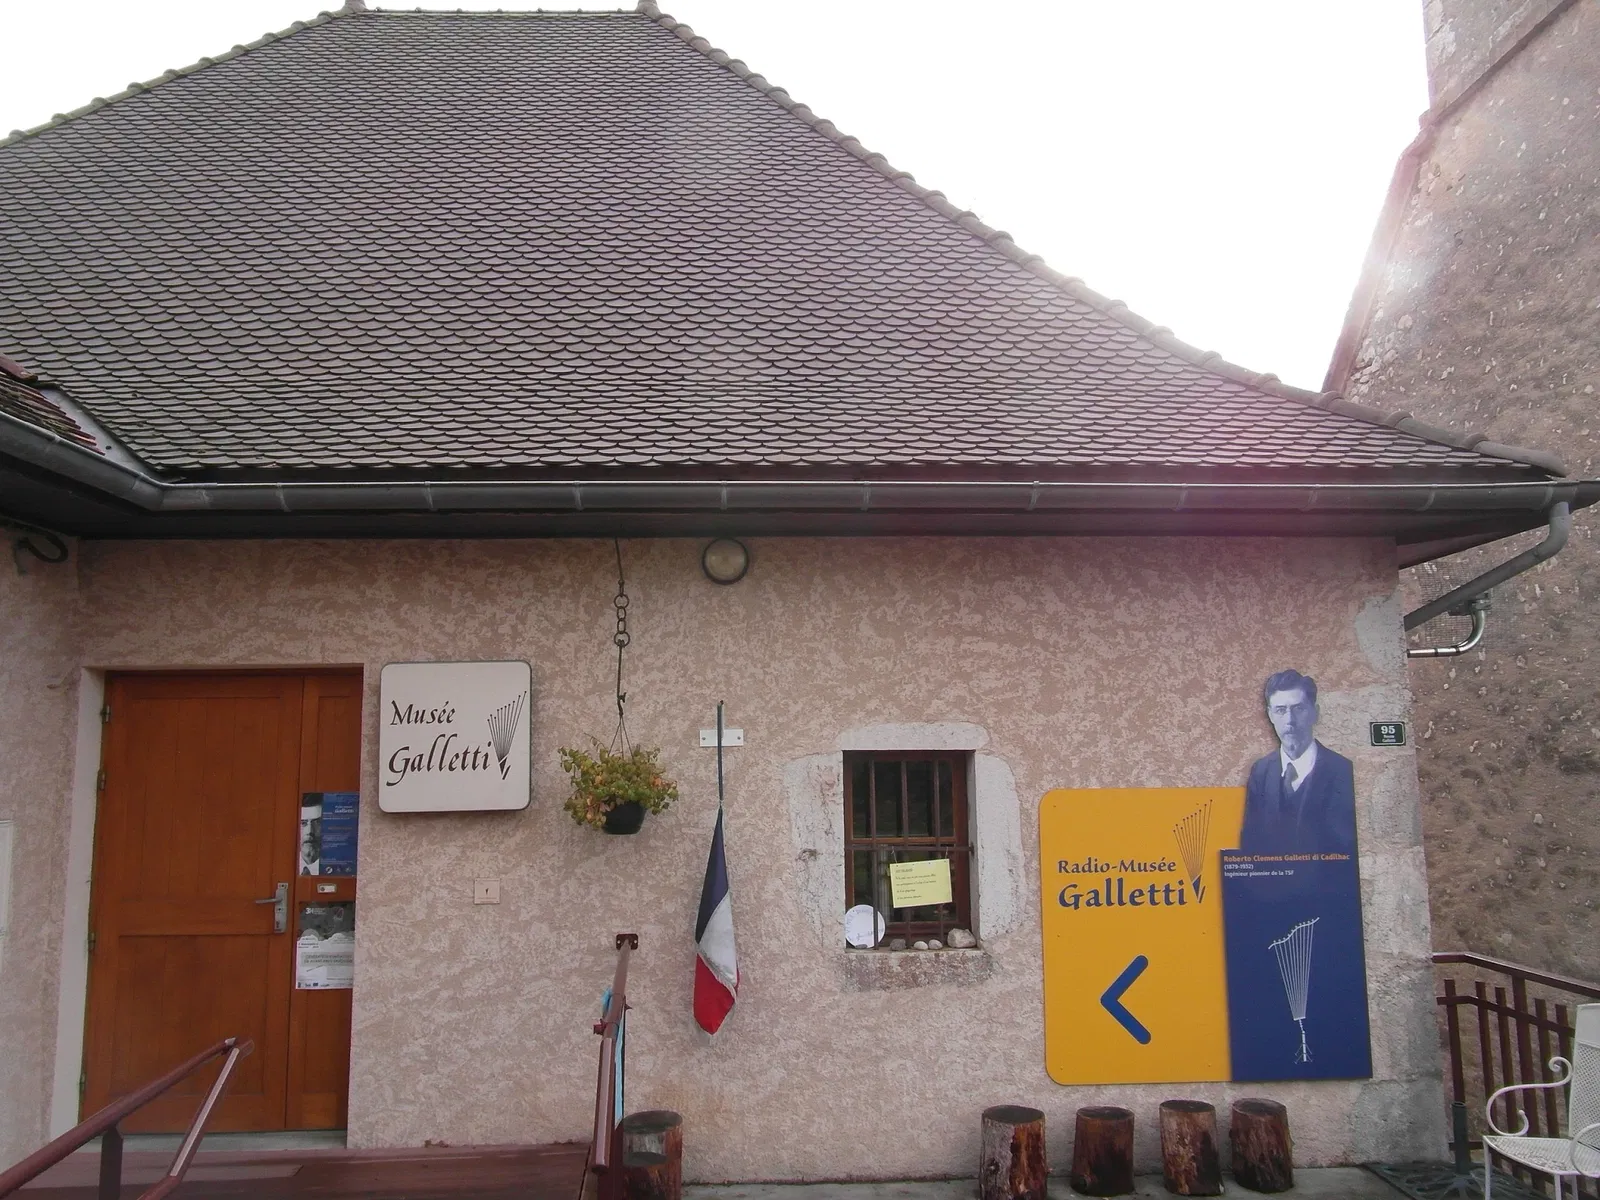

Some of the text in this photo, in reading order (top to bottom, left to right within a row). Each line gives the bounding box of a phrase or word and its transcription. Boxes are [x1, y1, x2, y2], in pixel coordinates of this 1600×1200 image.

[390, 700, 455, 725] Musée
[1381, 725, 1395, 734] 95
[386, 733, 492, 787] Galletti
[1058, 857, 1176, 874] Radio-Musée
[1312, 853, 1319, 861] di
[1320, 853, 1350, 861] Cadilhac
[1058, 877, 1188, 910] Galletti
